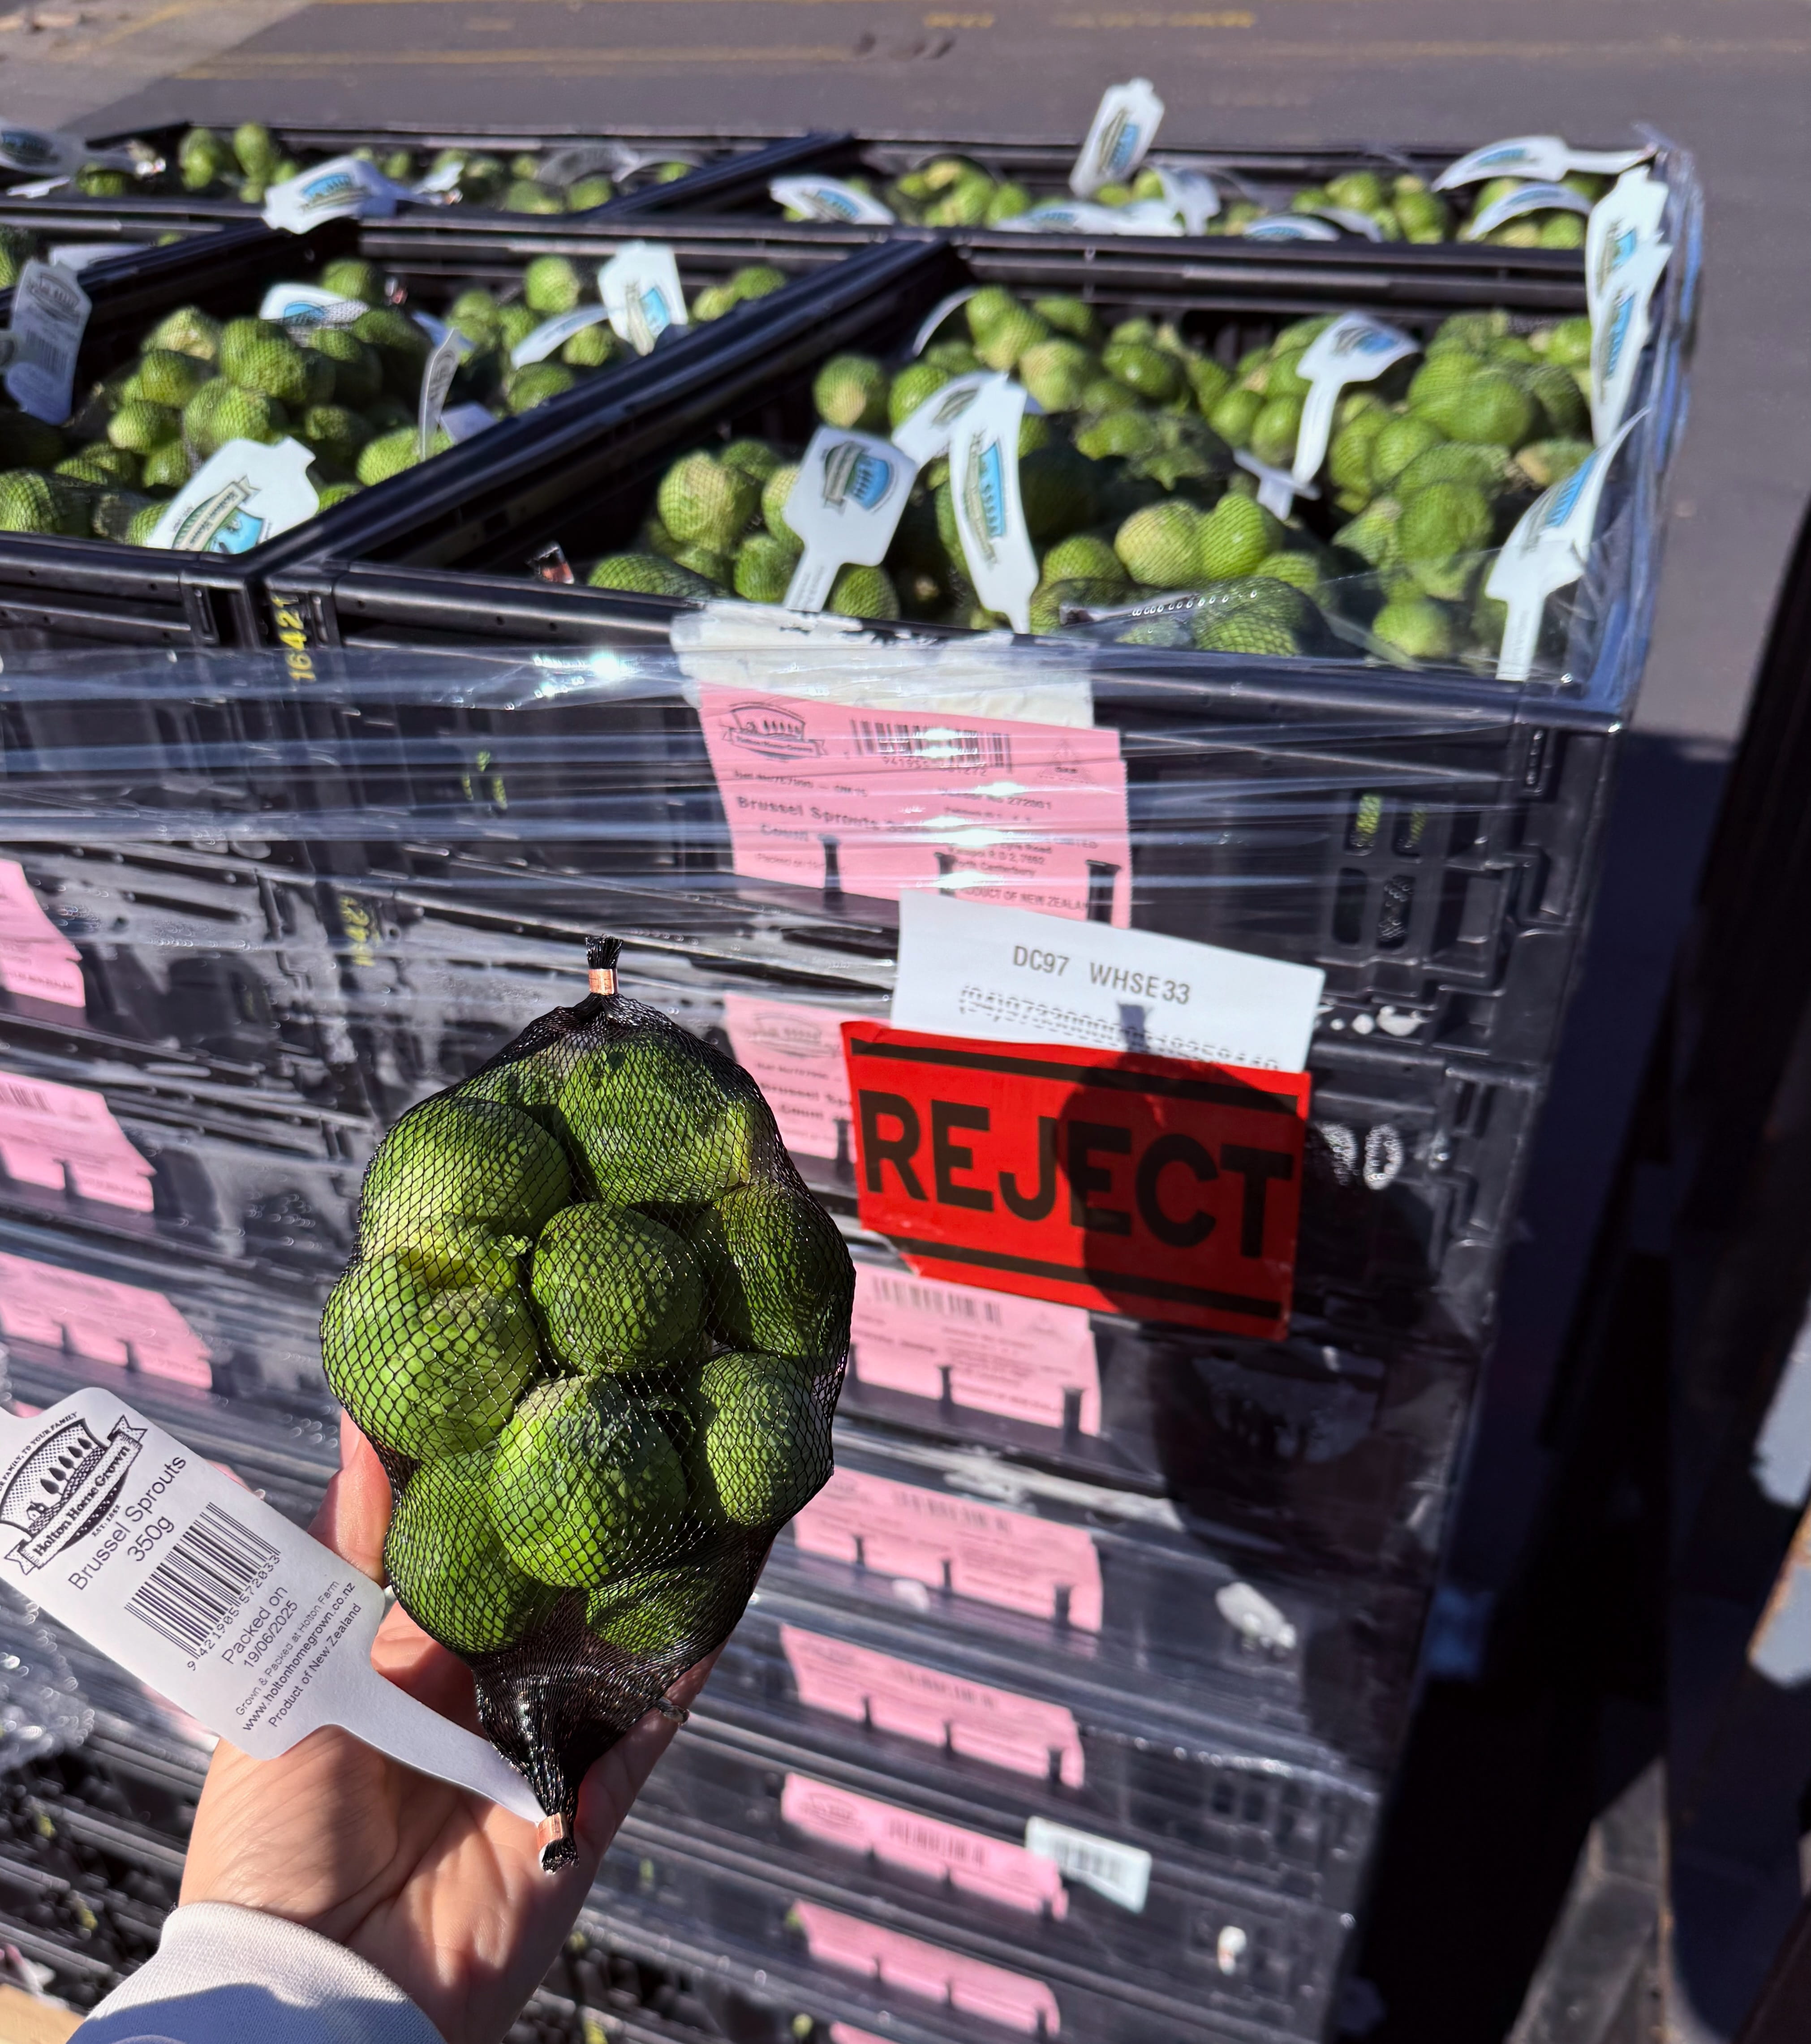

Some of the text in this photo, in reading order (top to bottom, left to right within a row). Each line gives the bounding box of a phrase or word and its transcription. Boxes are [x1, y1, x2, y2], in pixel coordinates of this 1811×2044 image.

[1012, 945, 1191, 1005] DC97 WHSE33
[858, 1089, 1295, 1259] REJECT
[22, 1445, 31, 1454] TO
[30, 1429, 51, 1445] YOUR
[50, 1411, 77, 1430] FAMILY
[33, 1446, 130, 1556] Holton Home Grown
[68, 1457, 186, 1590] Brussel Sprouts
[127, 1516, 175, 1562] 350g
[187, 1554, 280, 1671] 9 421905 572033
[221, 1587, 288, 1664] Packed on
[236, 1580, 340, 1716] Grown & Packed at Holton Farm
[243, 1582, 356, 1731] www.holtonhomegrown.co.nz
[244, 1600, 298, 1667] 19/06/2025
[268, 1602, 361, 1727] Product of New Zealand
